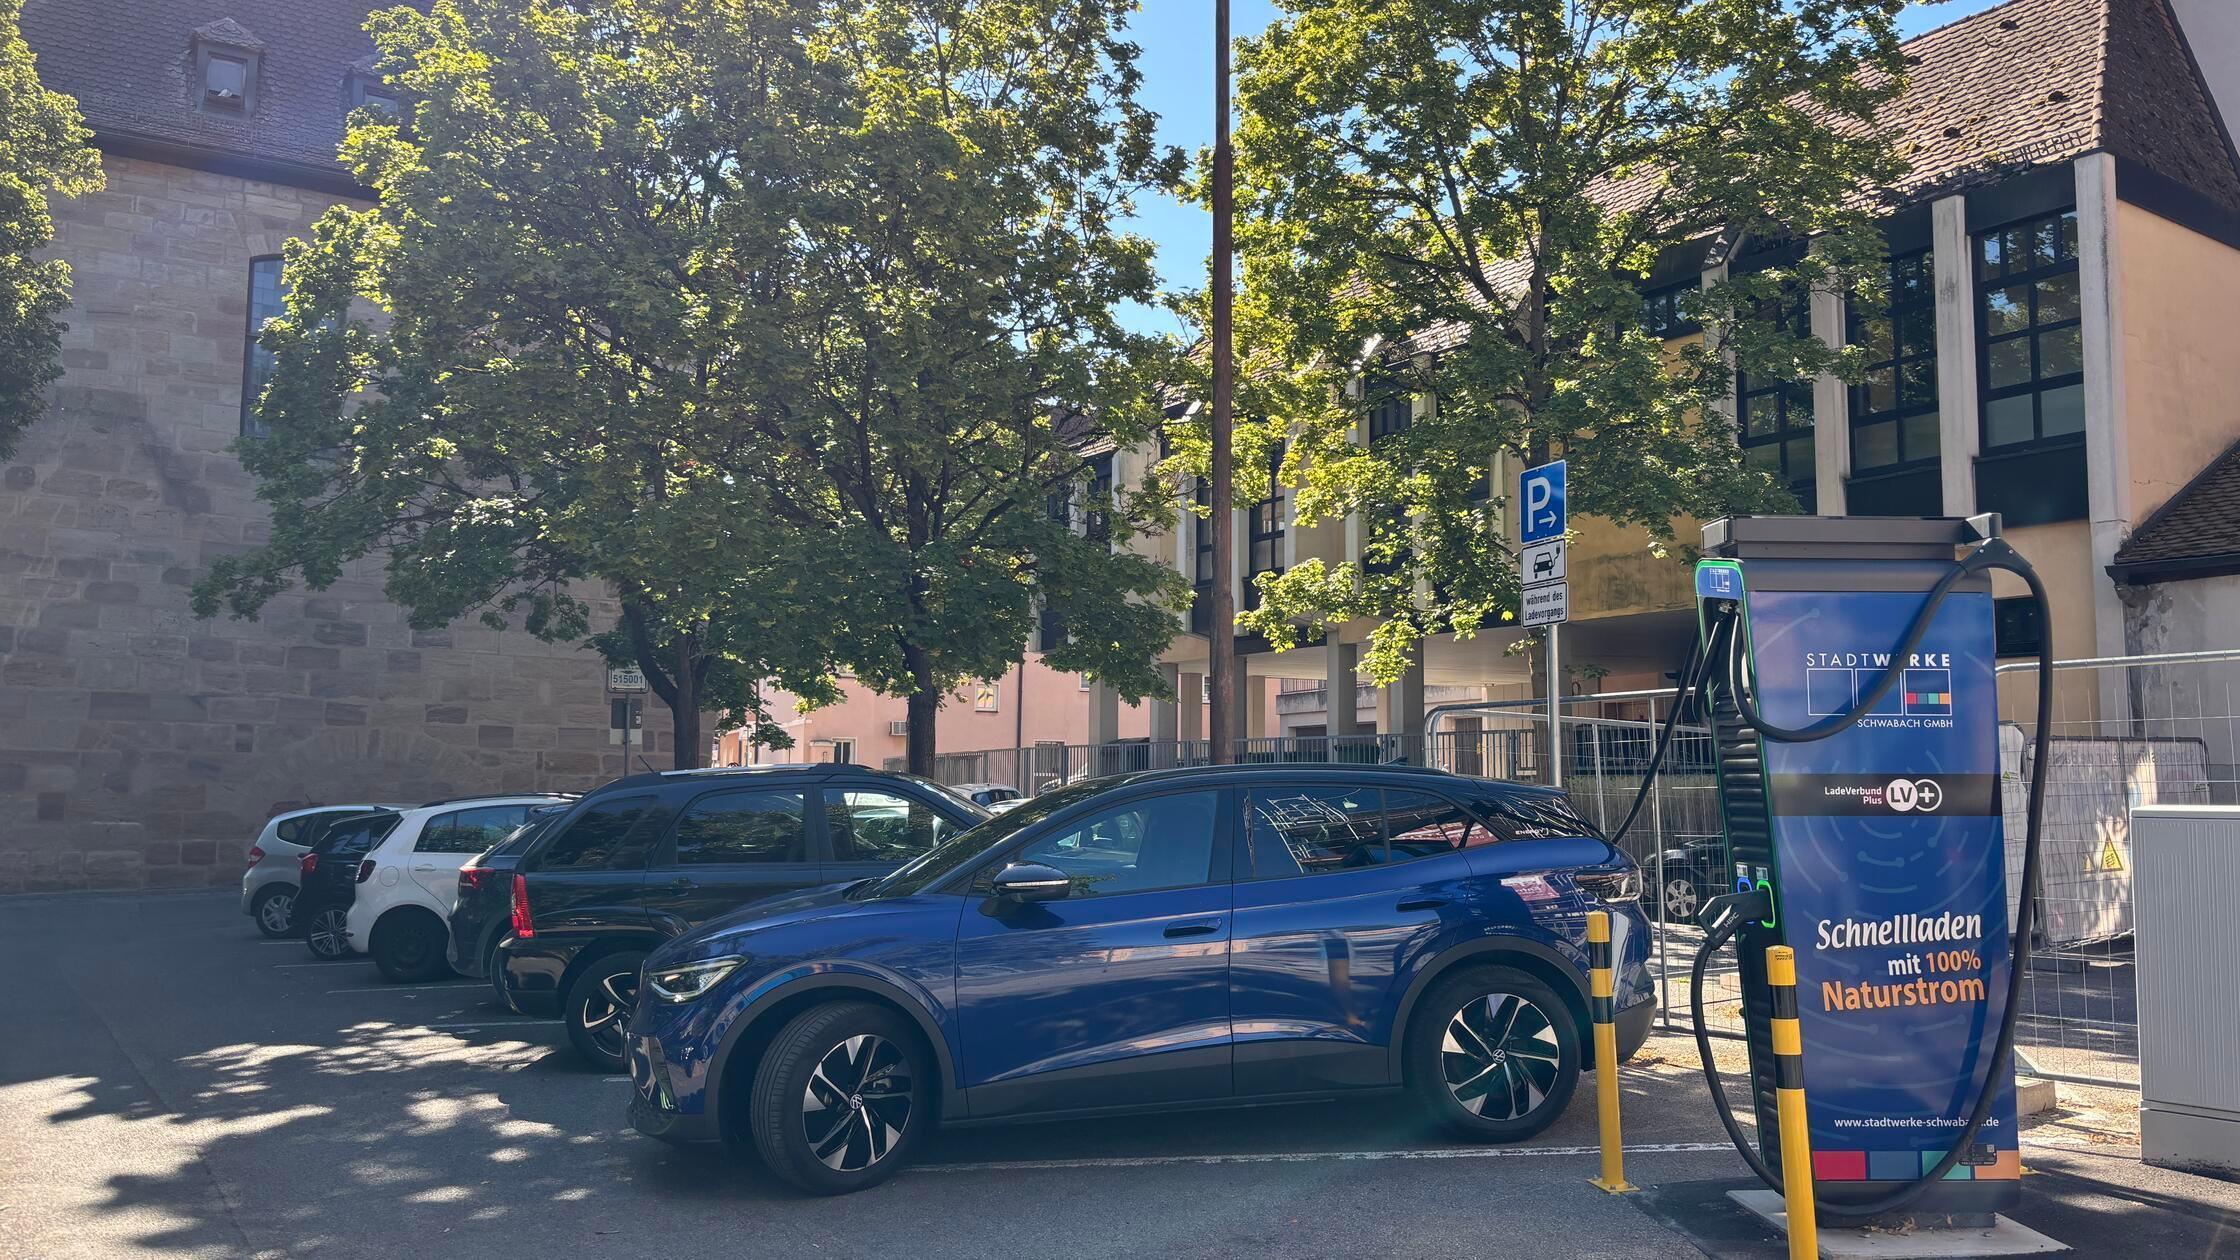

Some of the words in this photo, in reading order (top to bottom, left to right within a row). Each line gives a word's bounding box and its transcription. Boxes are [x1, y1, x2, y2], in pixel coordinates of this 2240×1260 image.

[1527, 476, 1551, 533] P
[1526, 592, 1551, 606] während
[1552, 590, 1563, 602] des
[1524, 605, 1564, 622] Ladevorgangs
[1806, 653, 1950, 667] STADTWRKE
[1857, 718, 1920, 728] SCHWABACH
[1923, 718, 1953, 728] GMBH
[1824, 786, 1882, 796] LadeVerbund
[1863, 795, 1883, 805] Plus
[1723, 911, 1740, 928] HPC
[1816, 911, 1982, 950] Schnellladen
[1887, 953, 1922, 976] mit
[1926, 949, 1982, 974] 100%
[1822, 977, 1985, 1012] Naturstrom
[1834, 1116, 2000, 1128] www.stadtwerke-schwab.de
